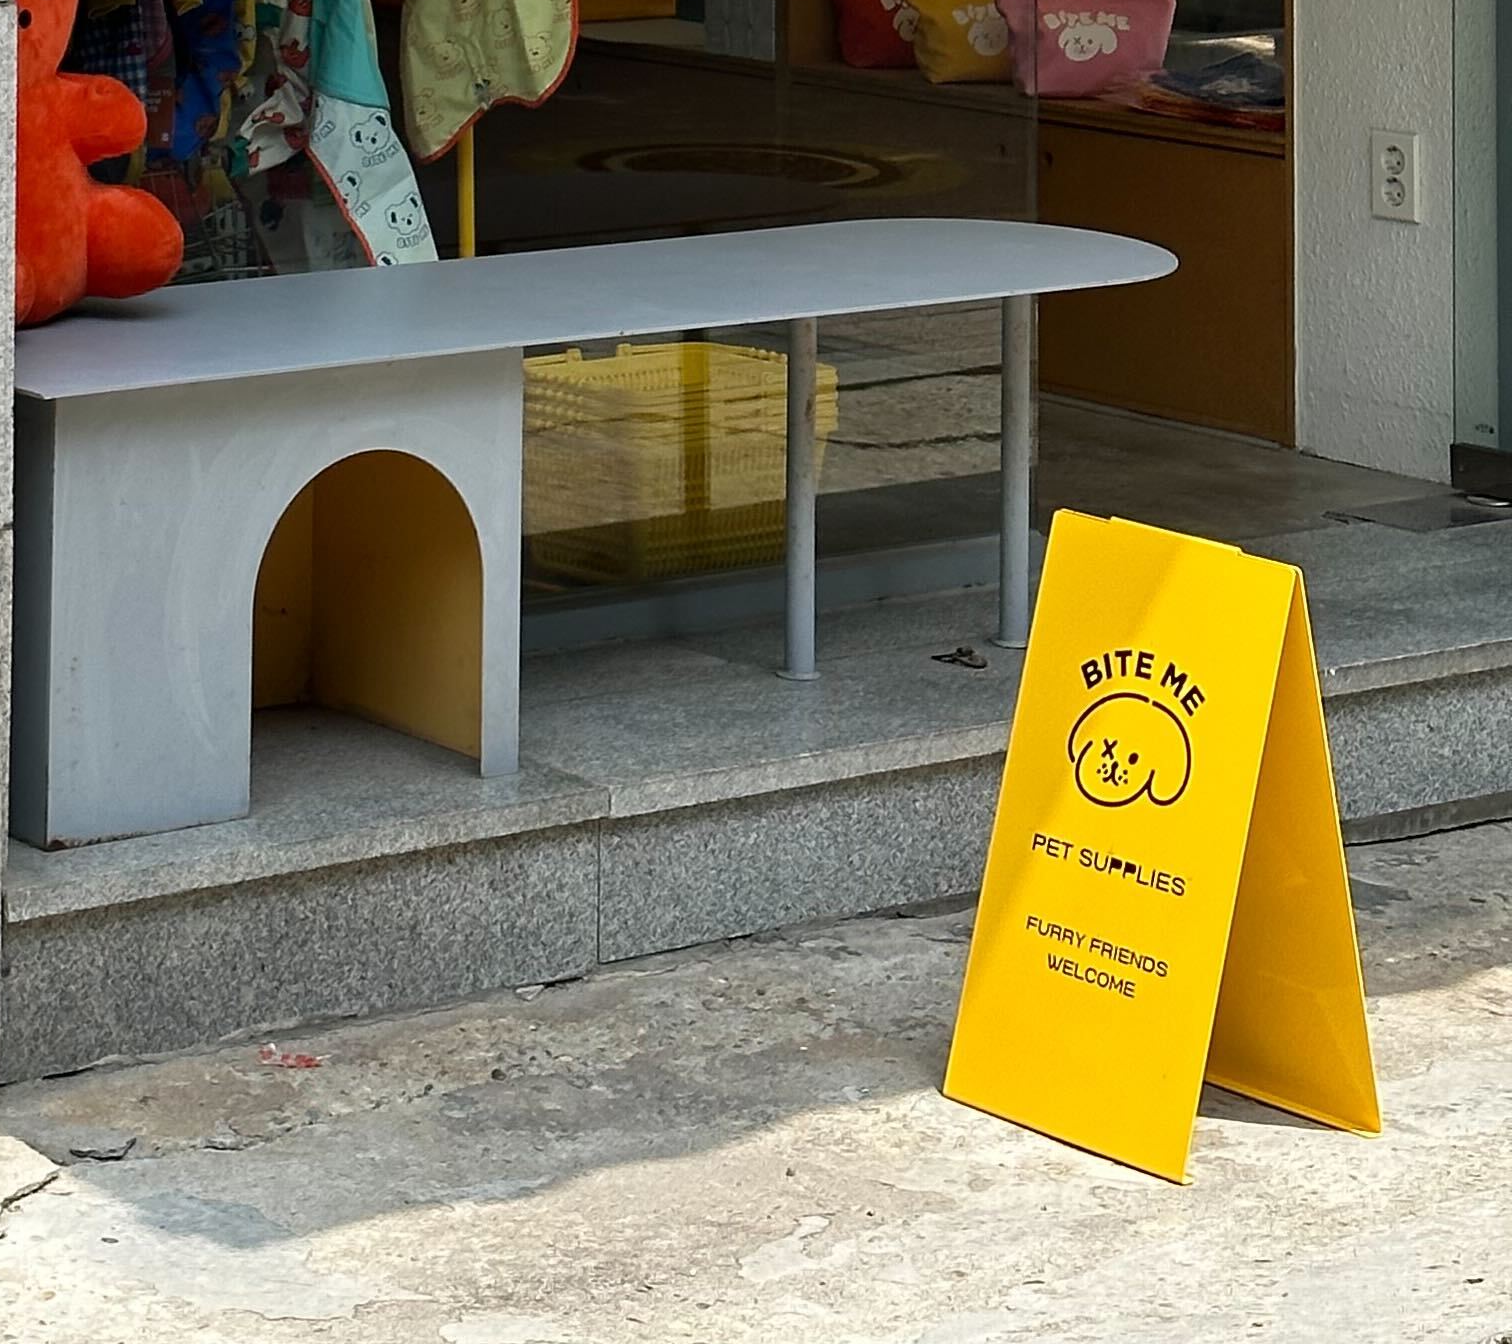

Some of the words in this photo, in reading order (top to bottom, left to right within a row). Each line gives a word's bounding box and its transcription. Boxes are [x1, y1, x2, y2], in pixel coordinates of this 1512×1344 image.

[1080, 649, 1156, 690] BITE
[1160, 662, 1206, 717] ME
[1032, 832, 1075, 861] PET
[1079, 848, 1187, 897] SUPPLIES
[1026, 916, 1086, 949] FURRY
[1089, 937, 1170, 978] FRIENDS
[1047, 953, 1137, 999] WELCOME
